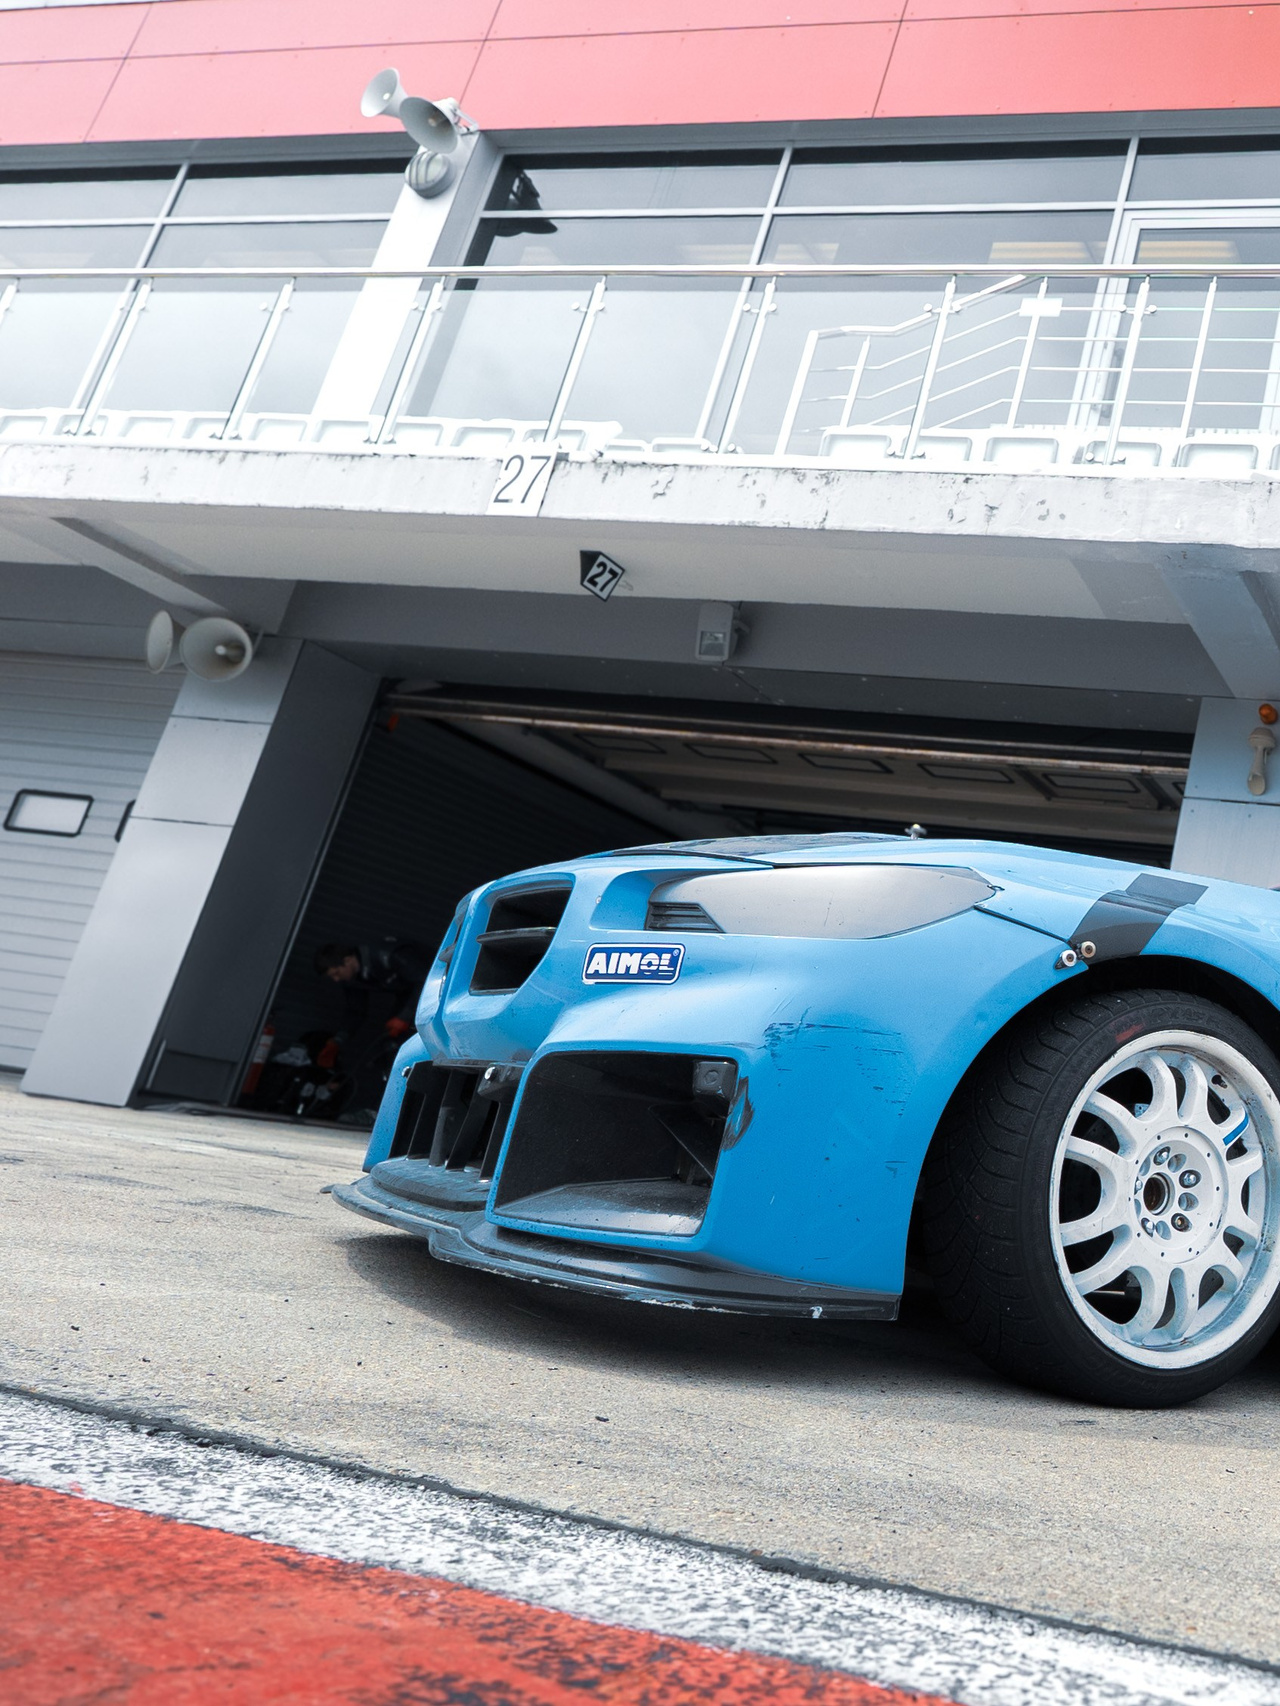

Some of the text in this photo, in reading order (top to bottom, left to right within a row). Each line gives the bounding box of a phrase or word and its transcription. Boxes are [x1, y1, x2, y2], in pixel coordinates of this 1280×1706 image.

[493, 454, 552, 504] 27
[586, 560, 620, 593] 27
[586, 952, 675, 975] AIMOL
